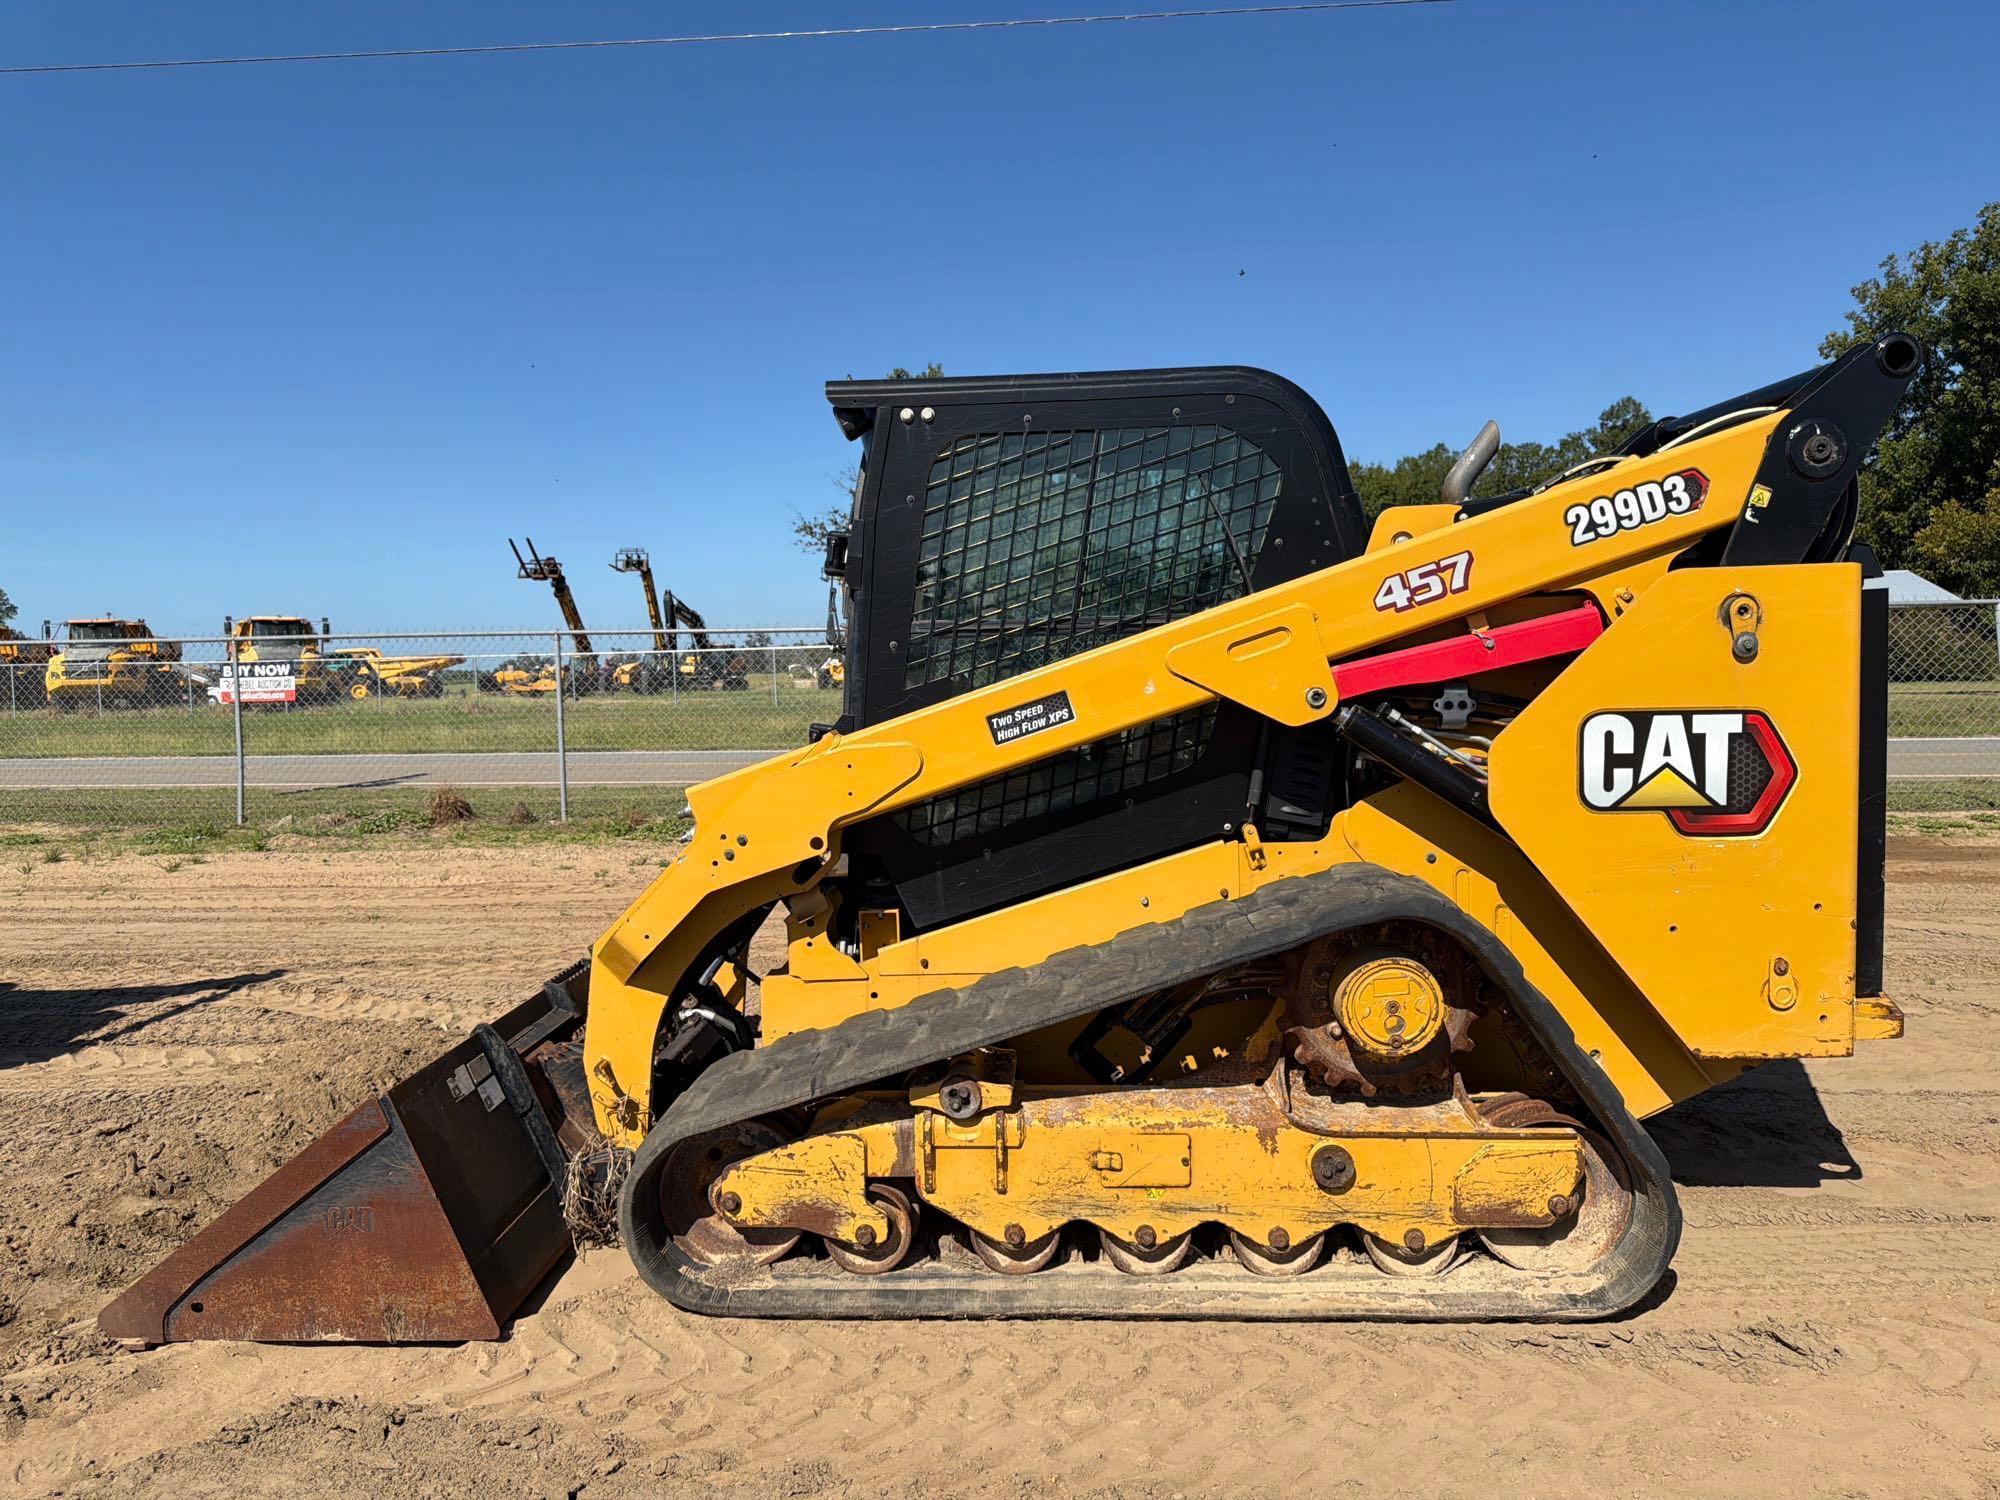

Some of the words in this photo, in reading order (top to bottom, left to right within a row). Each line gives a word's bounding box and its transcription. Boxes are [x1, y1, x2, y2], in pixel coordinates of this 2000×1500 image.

[1565, 474, 1691, 544] 299D3
[1374, 551, 1473, 612] 457
[254, 664, 291, 677] NOW
[991, 715, 1013, 729] TWO
[1014, 704, 1044, 722] SPEED
[997, 727, 1020, 741] HIGH
[1021, 717, 1046, 733] FLOW
[1048, 708, 1069, 724] XPS
[1583, 713, 1743, 808] CAT
[327, 1206, 375, 1233] CAT
